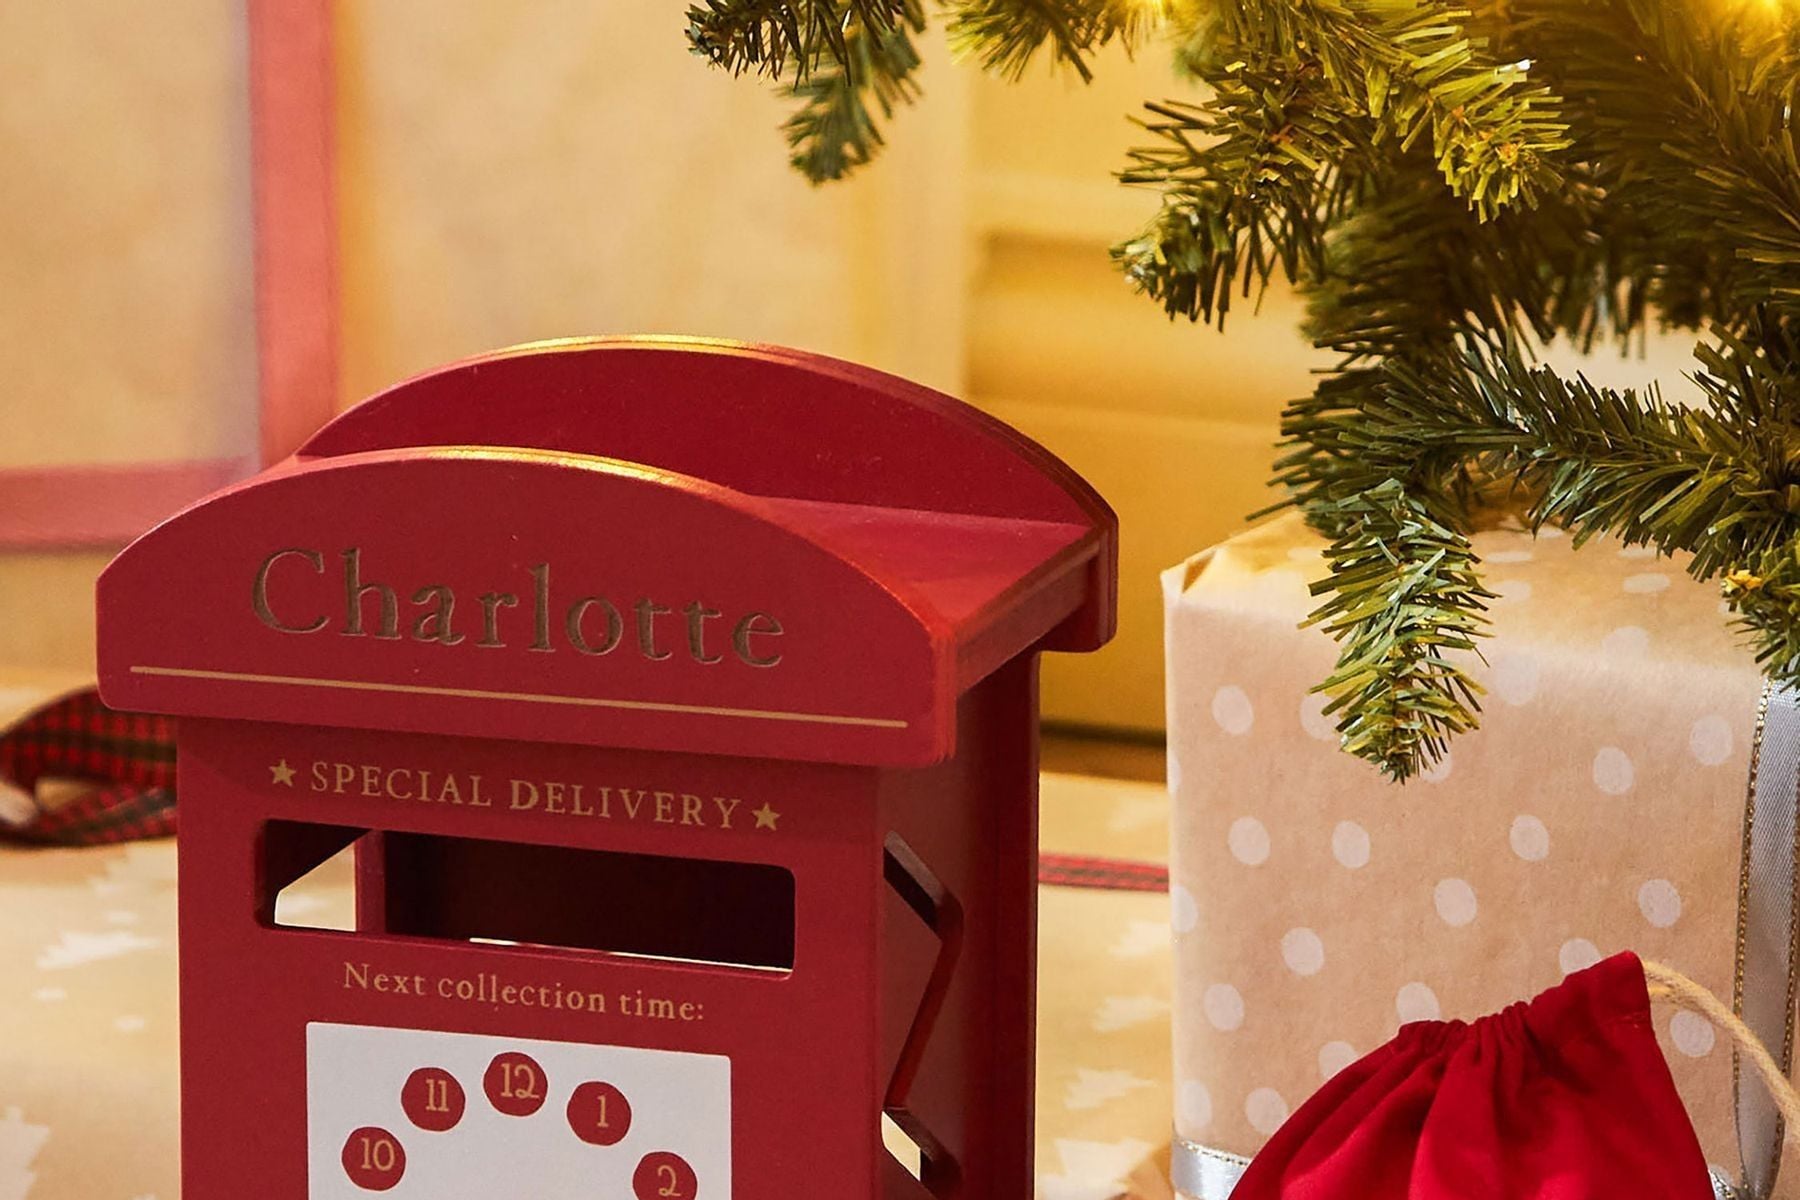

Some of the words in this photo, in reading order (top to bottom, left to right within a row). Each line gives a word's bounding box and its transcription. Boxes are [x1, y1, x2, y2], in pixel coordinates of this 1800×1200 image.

[252, 547, 784, 667] Charlotte
[311, 761, 492, 807] SPECIAL
[509, 779, 742, 828] DELIVERY
[343, 962, 425, 996] Next
[437, 973, 605, 1013] collection
[620, 990, 704, 1021] time:
[425, 1078, 450, 1112] 11
[500, 1062, 540, 1099] 12
[597, 1095, 609, 1128] 1
[360, 1137, 396, 1171] 10
[656, 1164, 682, 1197] 2
